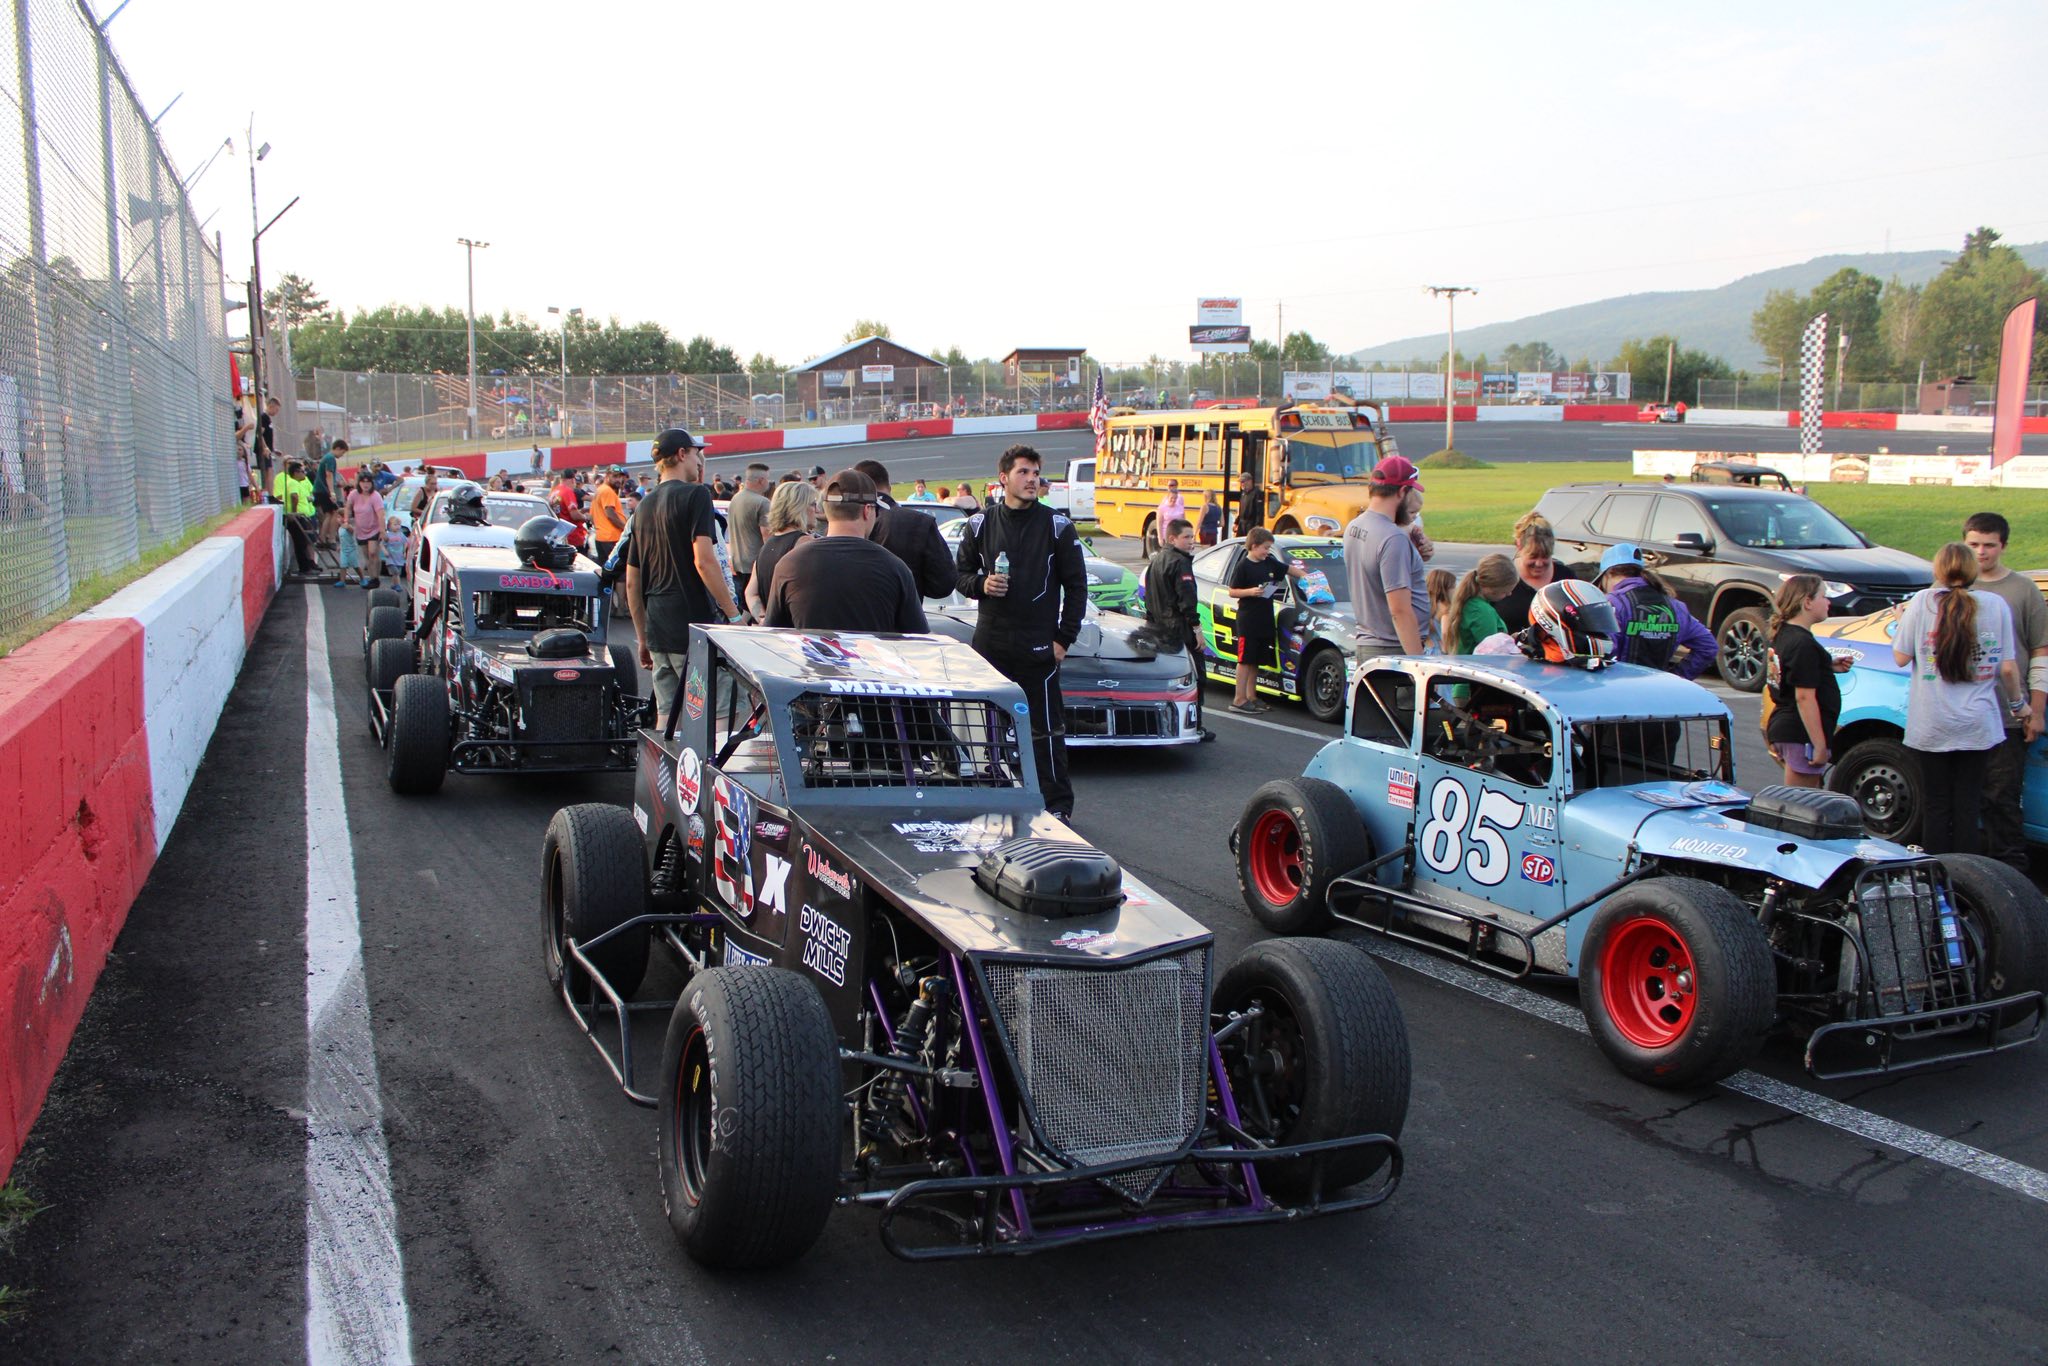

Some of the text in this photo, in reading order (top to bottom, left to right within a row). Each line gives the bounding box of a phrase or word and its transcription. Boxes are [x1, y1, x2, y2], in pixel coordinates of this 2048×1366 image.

[1302, 415, 1351, 426] SCHOOL BUS
[500, 574, 575, 590] SANBORN
[1626, 621, 1679, 636] UNLIMITED
[1525, 803, 1556, 831] ME
[1420, 777, 1526, 887] 85
[1669, 837, 1748, 858] MODIFIED
[1524, 857, 1551, 879] STP
[800, 904, 851, 959] DWIGHT
[803, 938, 845, 987] MILLS
